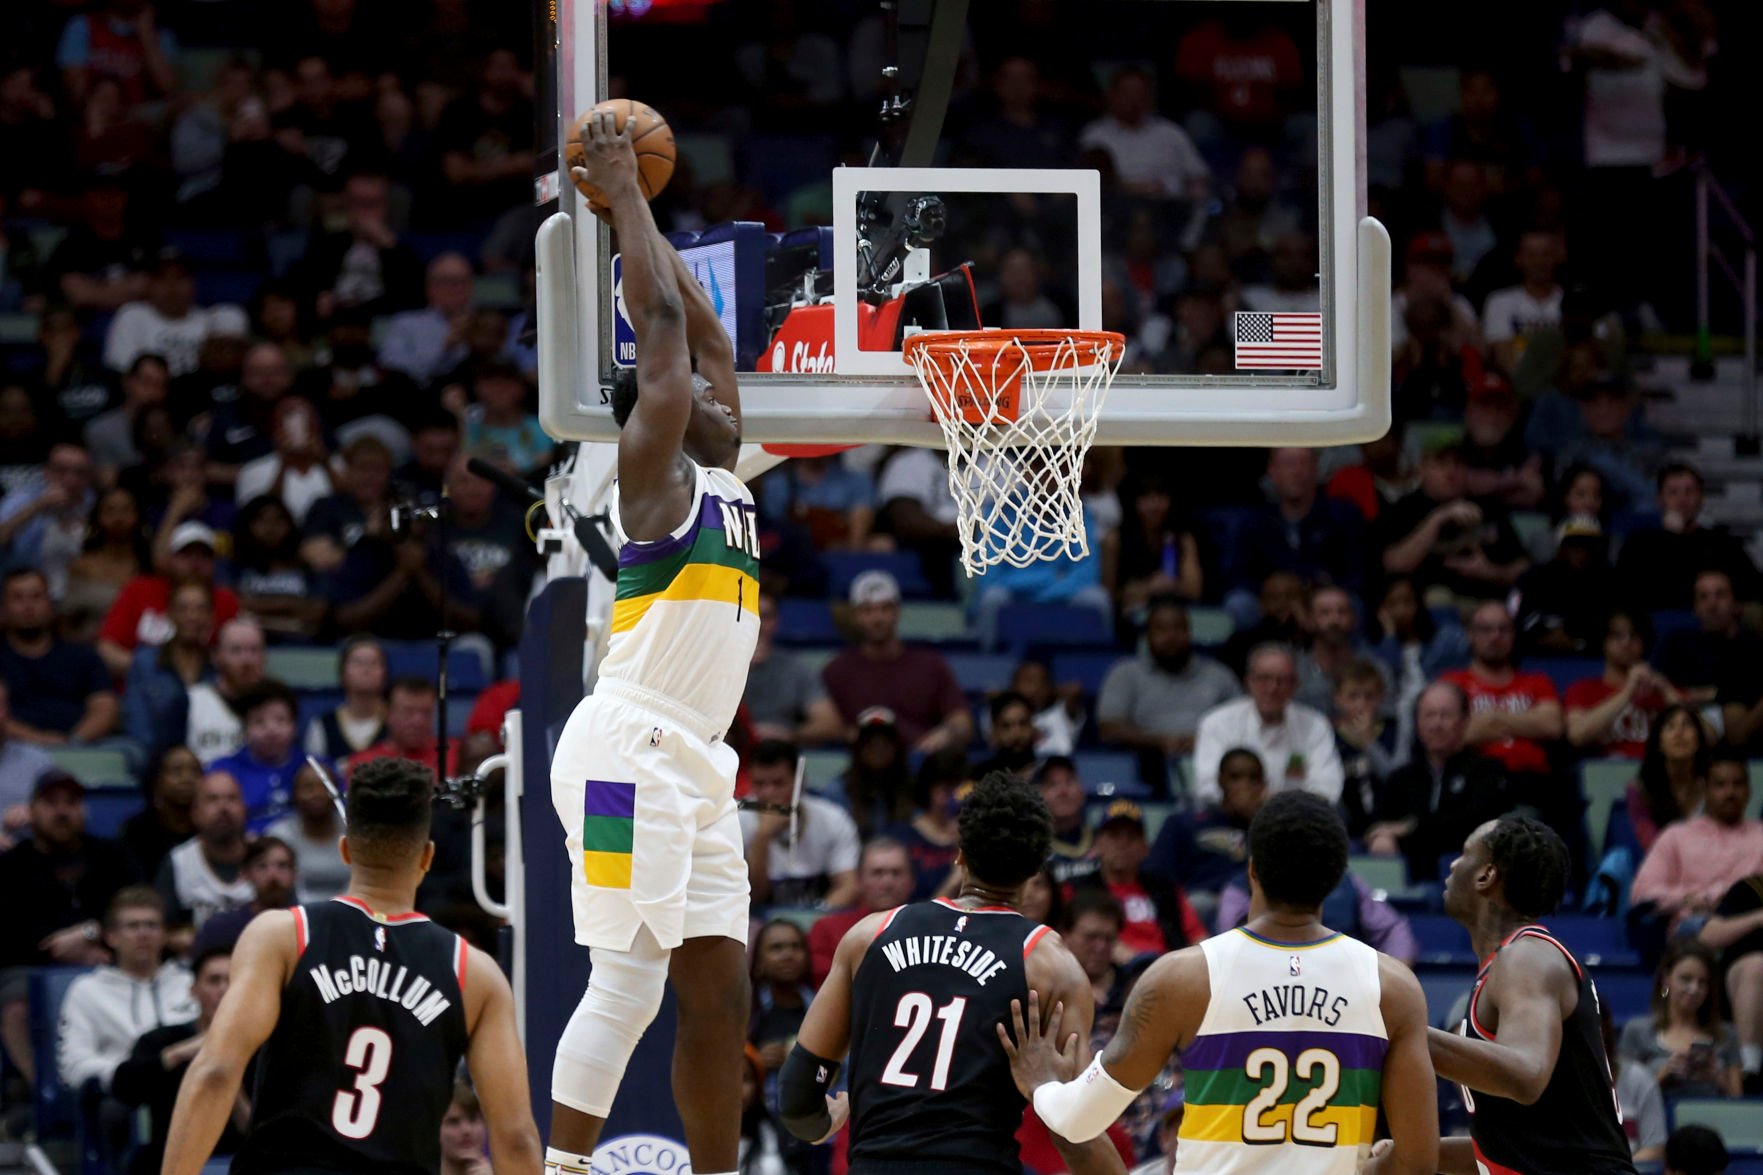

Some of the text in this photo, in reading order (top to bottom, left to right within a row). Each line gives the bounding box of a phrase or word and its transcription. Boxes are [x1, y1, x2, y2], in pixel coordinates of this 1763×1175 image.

[620, 342, 636, 360] NB
[958, 395, 1010, 409] SPALDNG
[309, 955, 451, 1027] McCOLLUM
[881, 935, 1007, 986] WHITESIDE
[1242, 985, 1349, 1027] FAVORS
[881, 992, 967, 1091] 21
[332, 1026, 393, 1139] 3
[1242, 1047, 1340, 1147] 22
